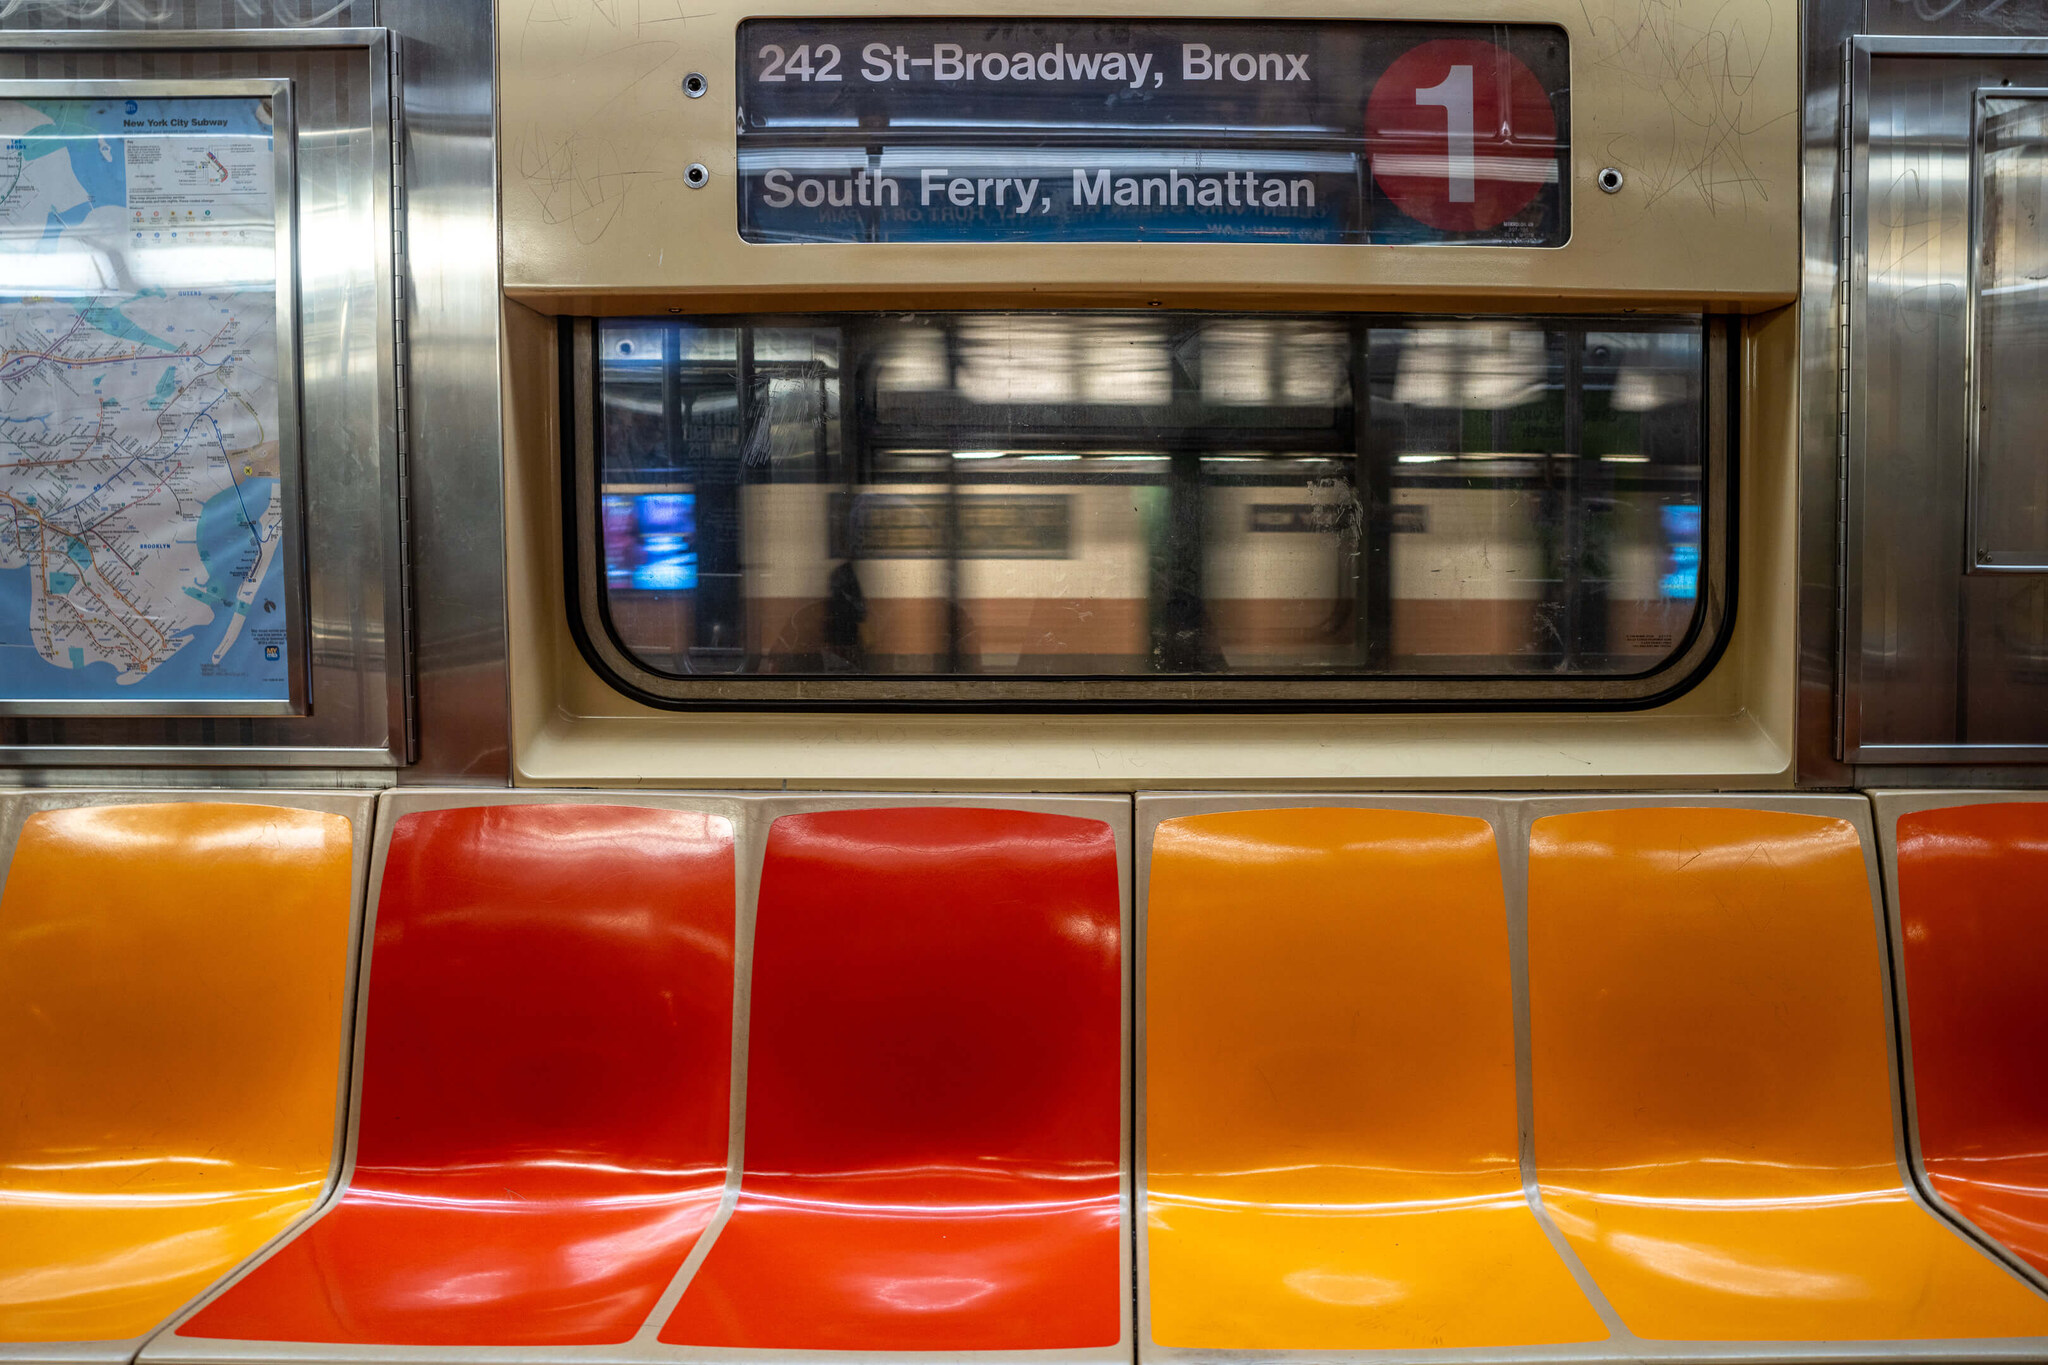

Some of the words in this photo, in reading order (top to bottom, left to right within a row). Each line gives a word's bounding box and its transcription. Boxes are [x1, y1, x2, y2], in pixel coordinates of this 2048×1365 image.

[758, 43, 843, 82] 242
[860, 42, 1164, 89] St-Broadway,
[1182, 43, 1311, 82] Bronx
[123, 119, 145, 128] New
[147, 119, 168, 127] York
[170, 118, 189, 128] City
[191, 118, 229, 128] Subway
[1415, 64, 1475, 203] 1
[763, 168, 899, 208] South
[920, 168, 1051, 214] Ferry,
[1072, 168, 1316, 207] Manhattan
